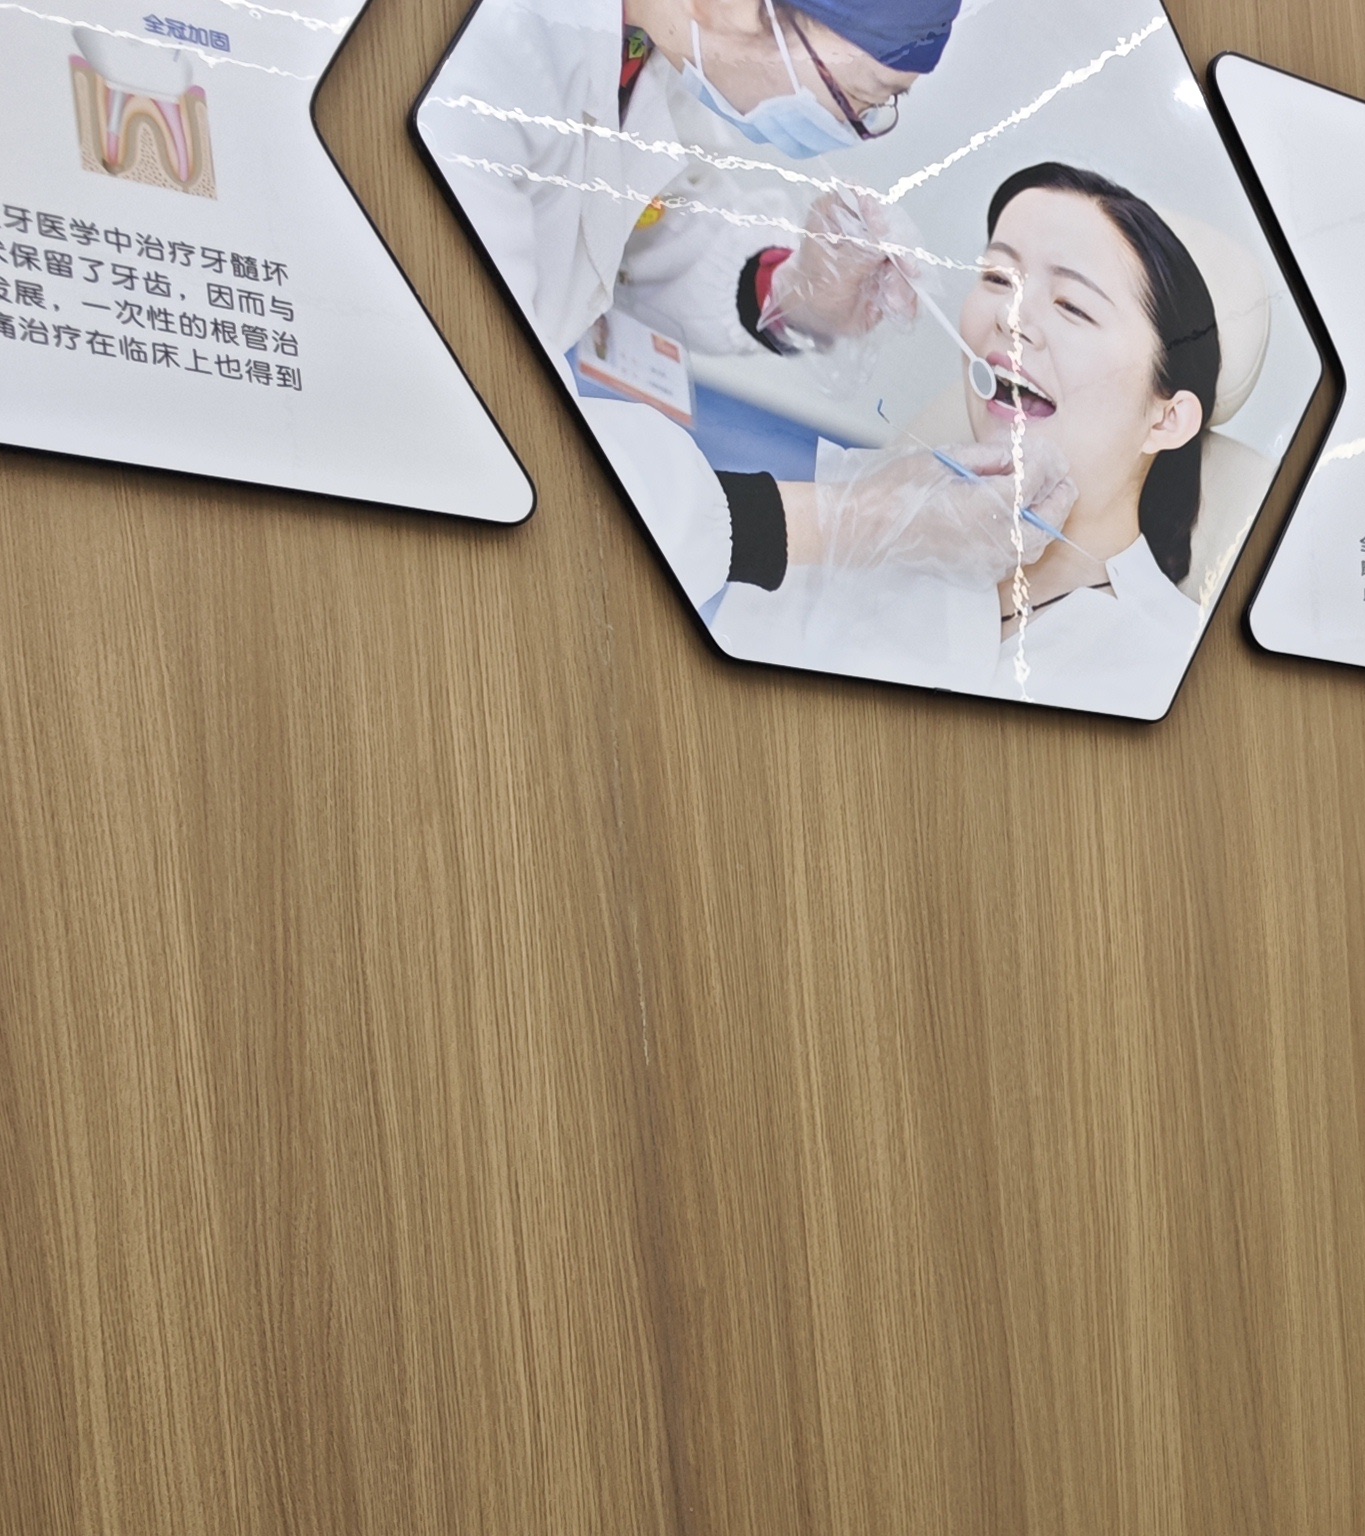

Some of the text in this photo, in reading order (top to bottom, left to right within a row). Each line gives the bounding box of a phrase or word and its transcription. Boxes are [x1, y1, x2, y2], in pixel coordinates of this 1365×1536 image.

[142, 13, 231, 52] 全冠加固
[0, 240, 294, 322] 保留了牙齿，因而与
[2, 204, 289, 287] 牙医学中治疗牙髓坏
